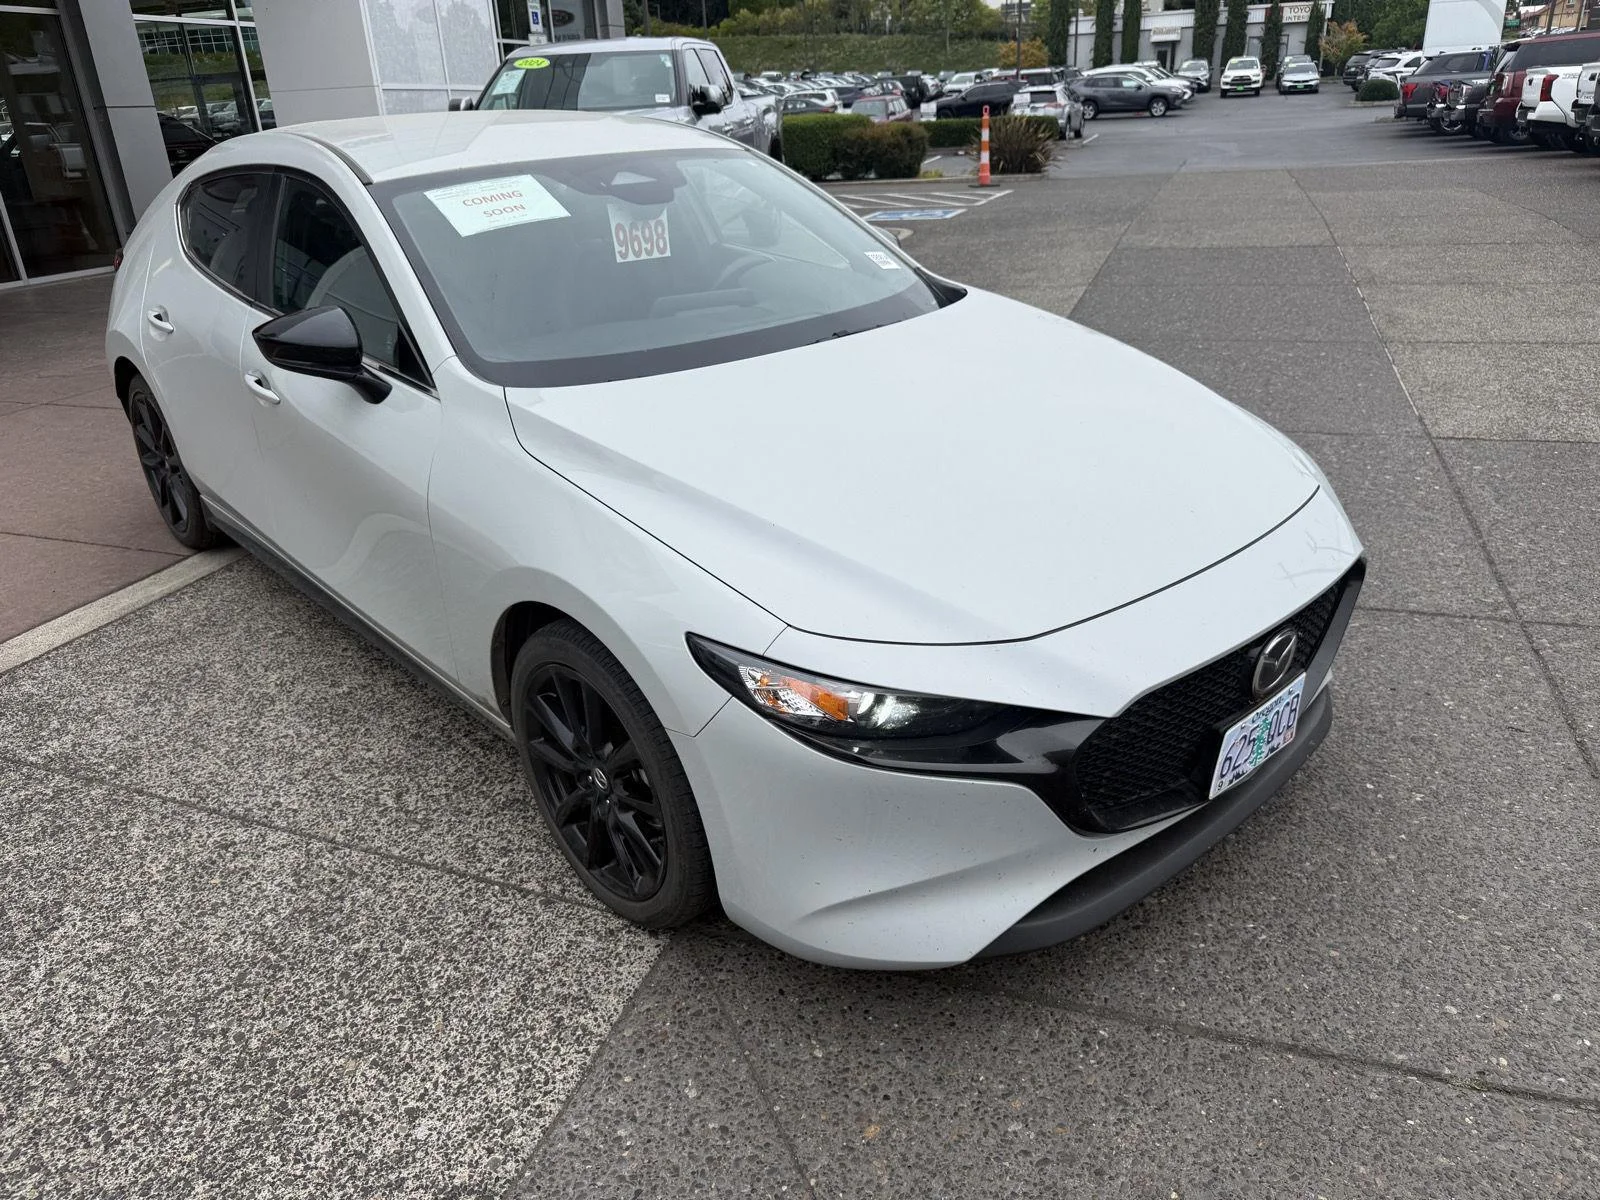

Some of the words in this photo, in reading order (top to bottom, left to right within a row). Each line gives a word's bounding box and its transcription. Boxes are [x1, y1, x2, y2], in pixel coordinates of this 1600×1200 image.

[462, 190, 524, 207] COMING
[483, 204, 526, 218] SOON
[614, 219, 668, 260] 9698
[1219, 724, 1260, 779] 625
[1266, 693, 1300, 744] QCB
